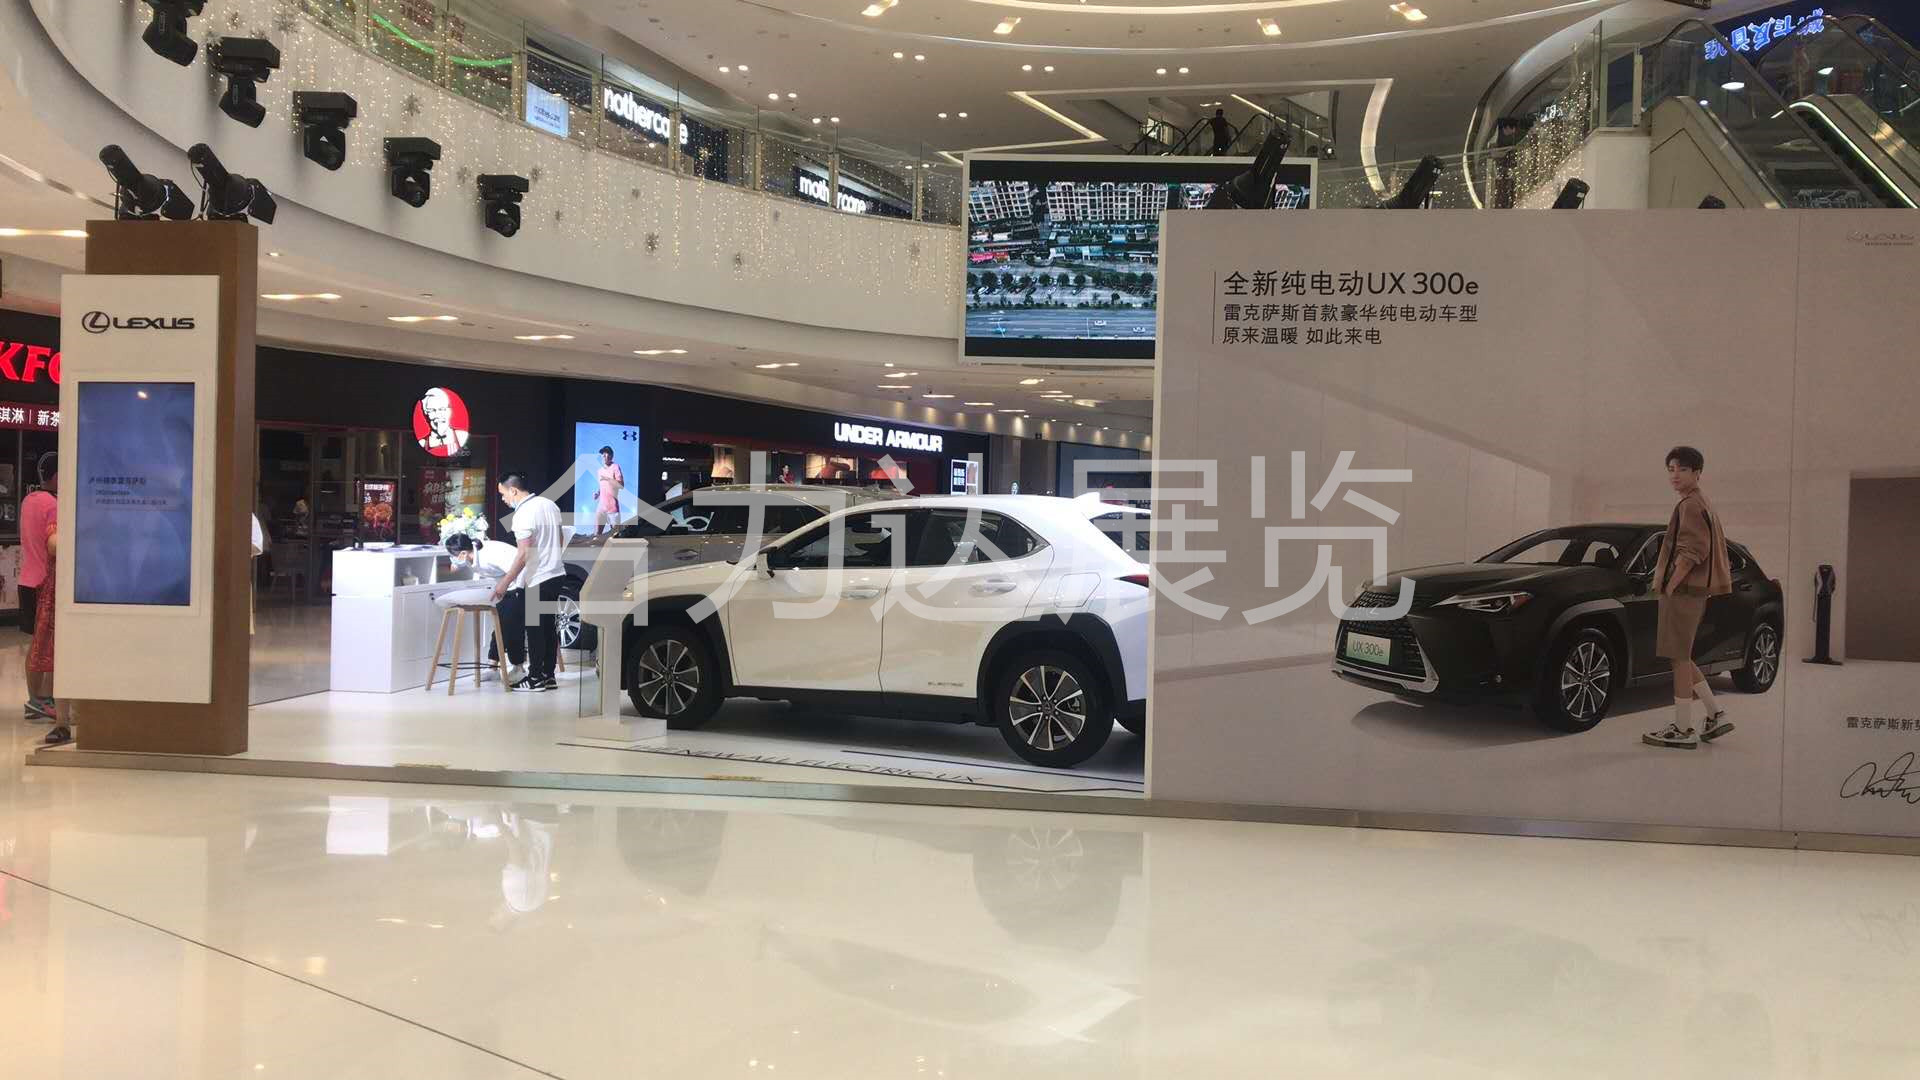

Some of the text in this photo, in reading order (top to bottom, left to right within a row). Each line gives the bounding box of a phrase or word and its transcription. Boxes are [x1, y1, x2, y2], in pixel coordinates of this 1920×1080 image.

[603, 86, 689, 145] mothercae
[799, 176, 868, 214] mothrcare
[1223, 270, 1479, 297] 全新纯电动UX 300e
[113, 317, 195, 330] LEXUS
[1223, 303, 1479, 323] 雷克萨斯首款豪华纯电动车型
[1222, 326, 1382, 345] 原来温暖 如此来电
[834, 422, 942, 452] UNDER ARMOUR
